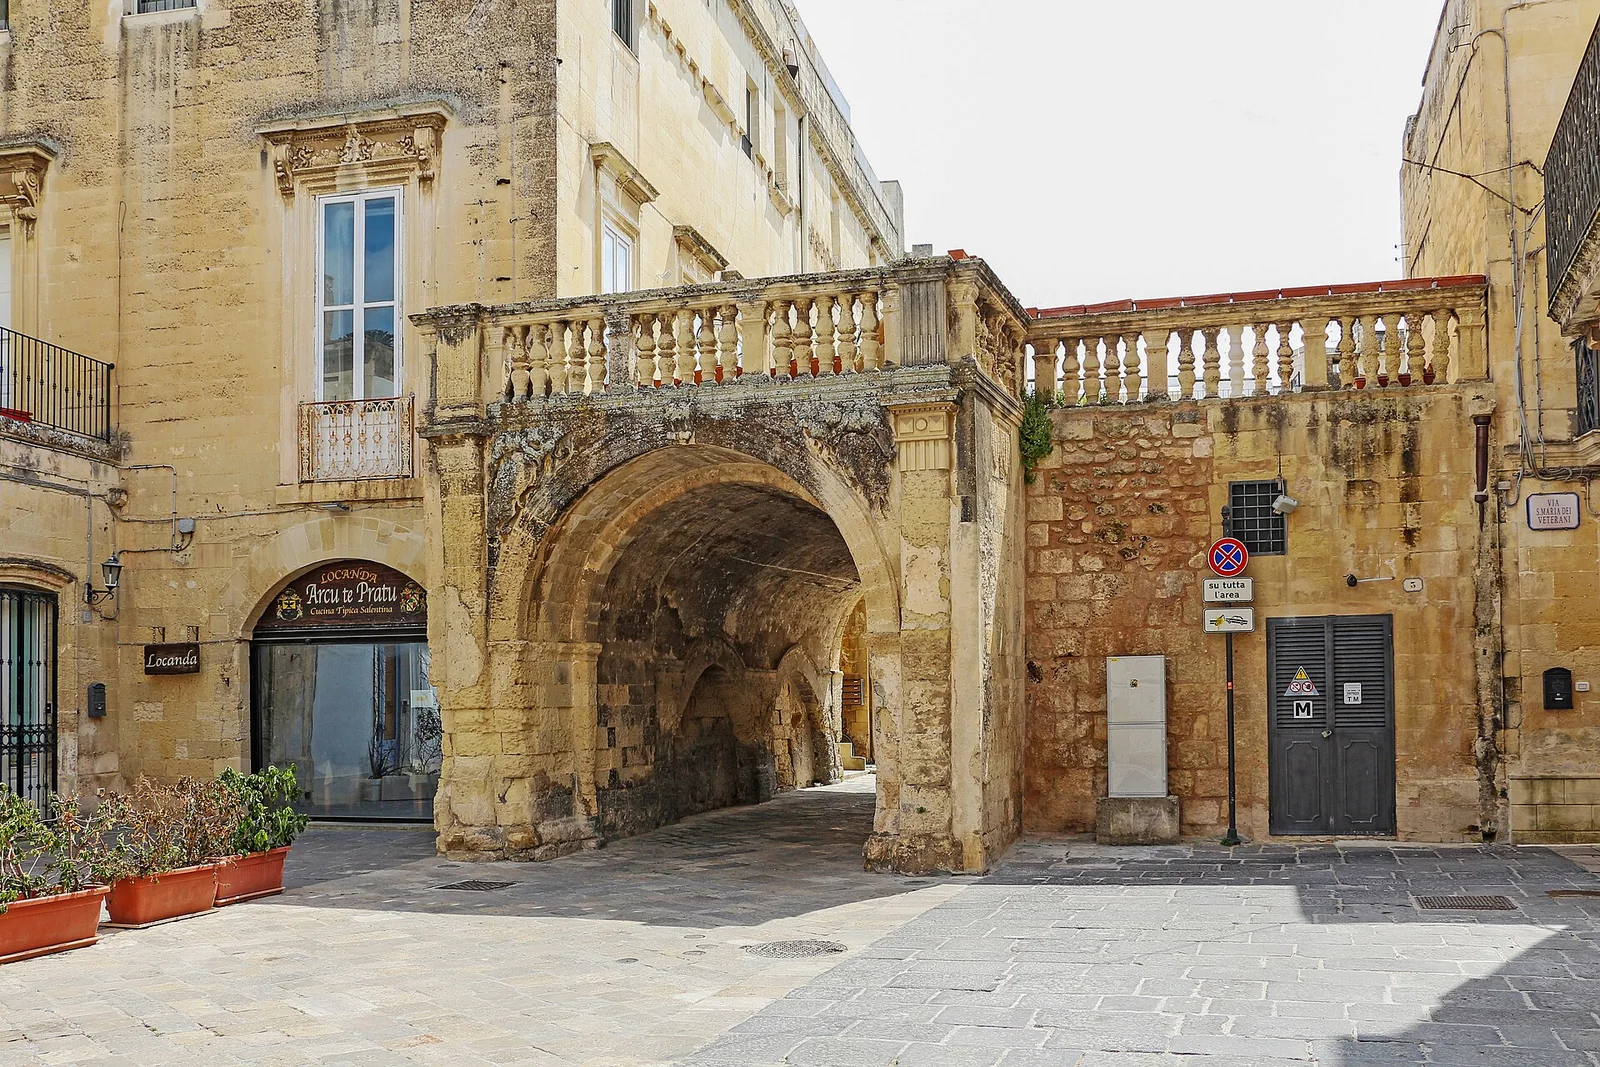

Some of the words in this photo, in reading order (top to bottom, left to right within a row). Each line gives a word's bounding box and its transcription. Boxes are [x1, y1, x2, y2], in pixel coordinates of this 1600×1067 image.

[1547, 499, 1560, 507] VIA
[1562, 507, 1572, 515] DEI
[1537, 516, 1571, 524] VETERANI
[320, 567, 378, 585] LOCANDA
[1208, 582, 1220, 590] su
[1222, 581, 1246, 589] tutta
[305, 583, 340, 605] Arcu
[342, 588, 354, 604] te
[356, 581, 398, 603] Pratu
[1214, 591, 1240, 599] l'area
[310, 606, 335, 616] Cucina
[335, 605, 359, 618] Tipica
[360, 604, 393, 615] Salentina
[145, 649, 198, 668] Locanda
[1295, 702, 1311, 717] M
